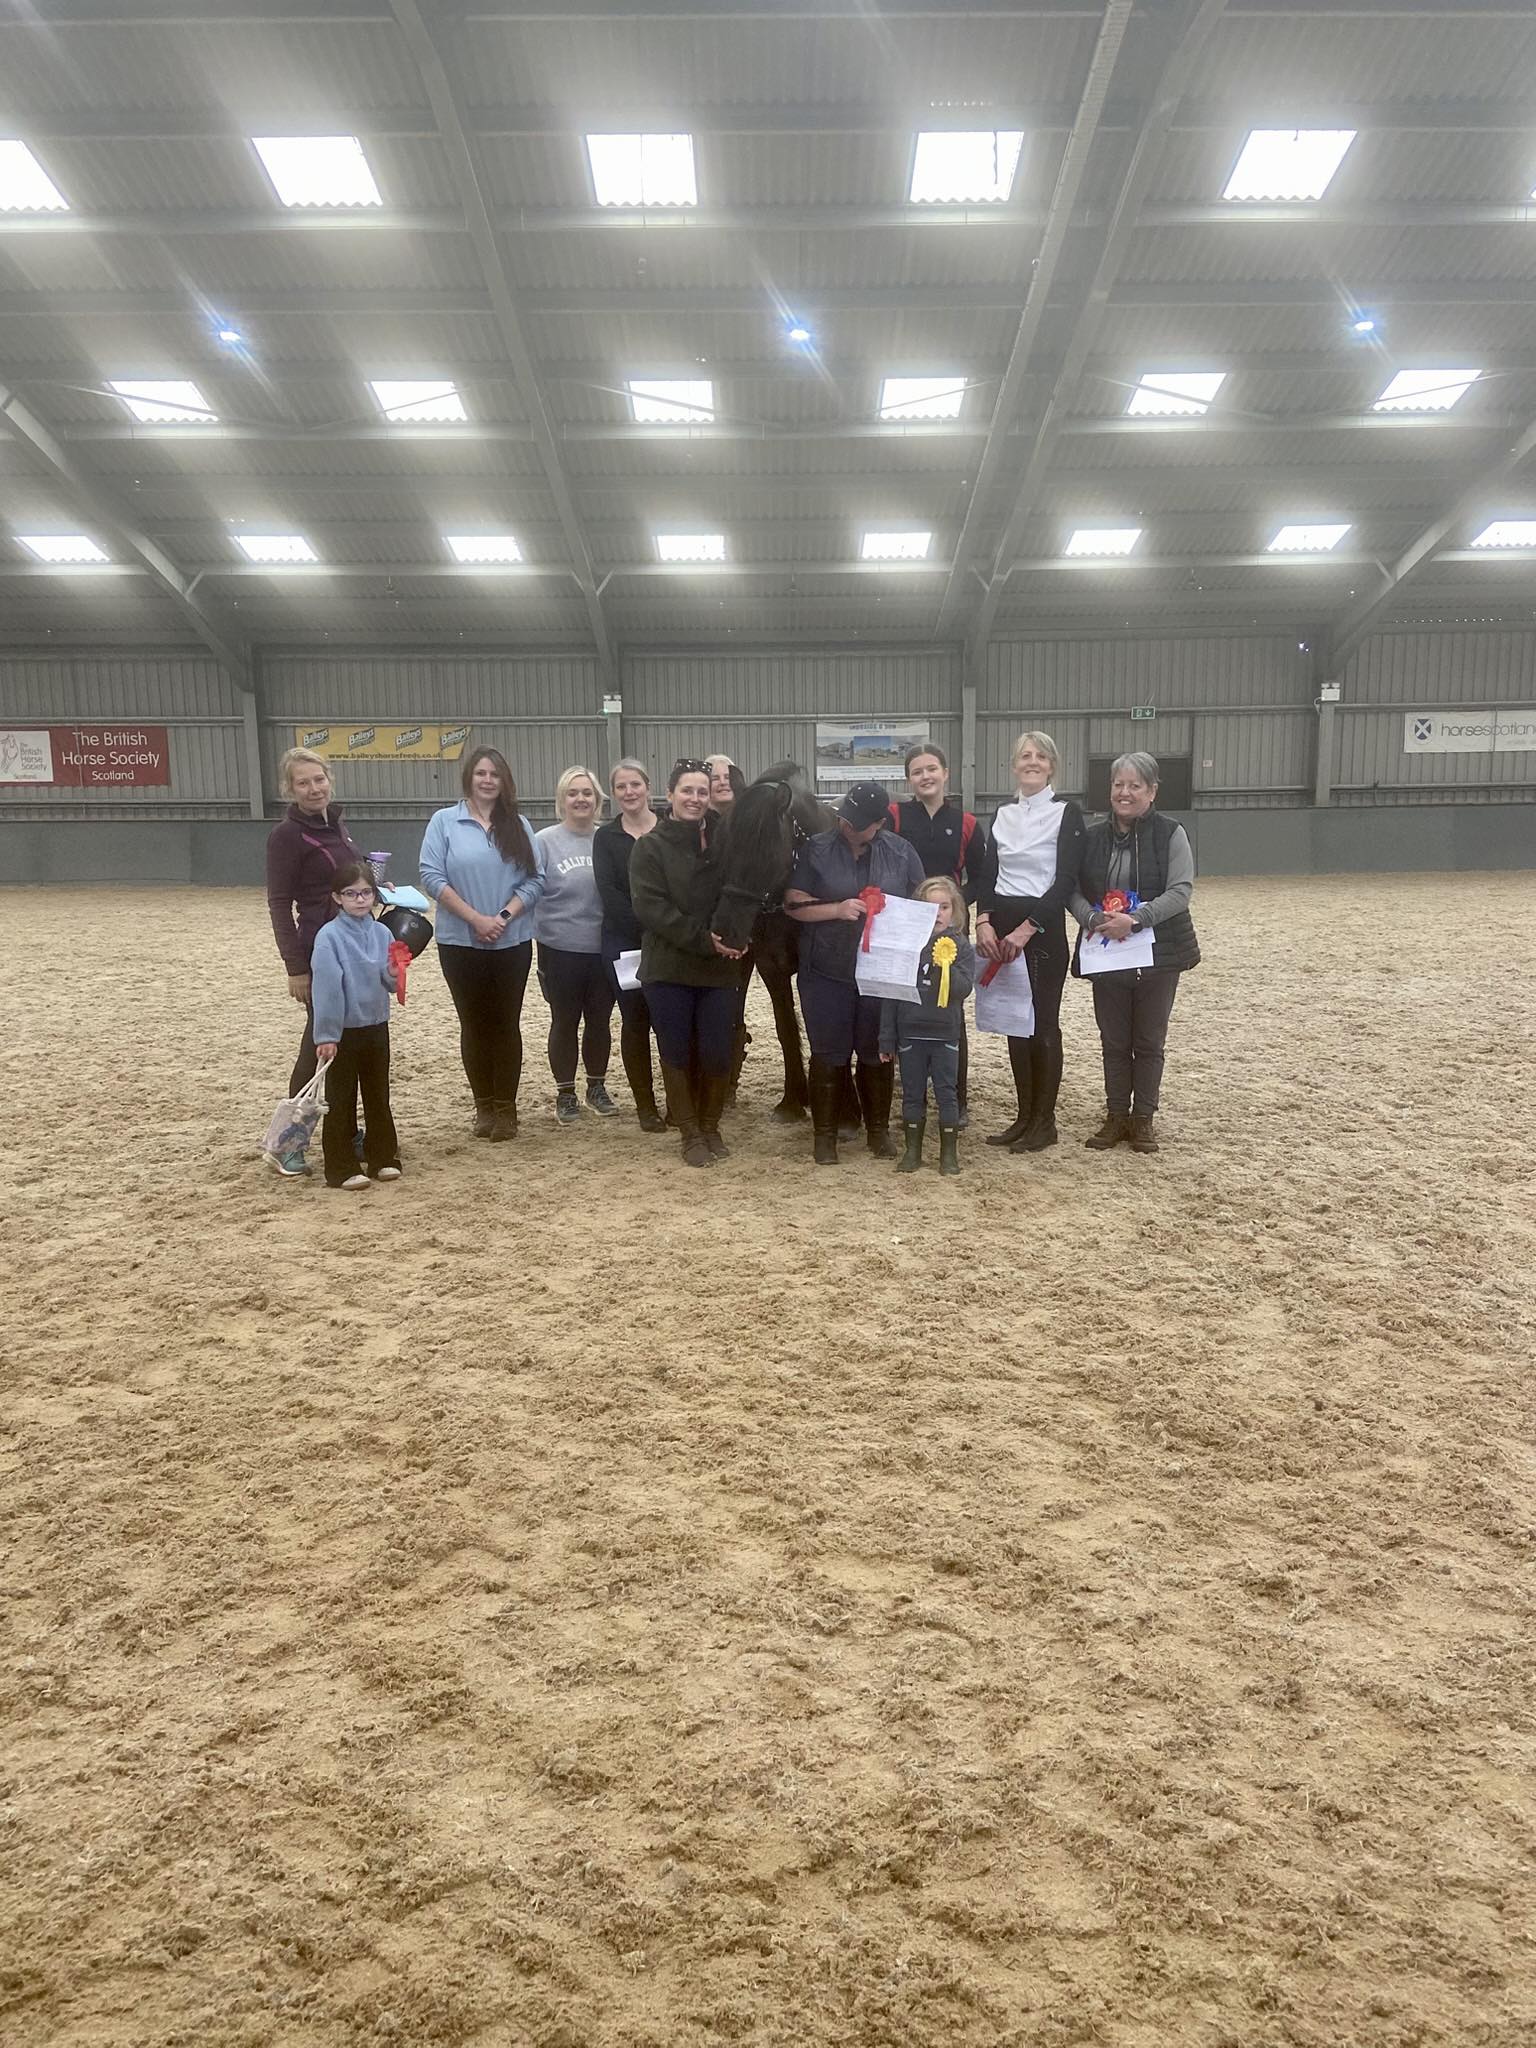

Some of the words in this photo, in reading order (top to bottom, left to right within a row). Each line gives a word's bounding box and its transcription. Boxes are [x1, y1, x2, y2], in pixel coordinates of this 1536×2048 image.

[72, 731, 100, 746] The
[103, 731, 148, 746] British
[303, 728, 329, 746] Baileys
[348, 728, 374, 745] Baileys
[396, 729, 421, 746] Baileys
[441, 728, 466, 745] Baileys
[62, 751, 106, 765] Horse
[109, 751, 160, 768] Society
[91, 770, 135, 781] Scotland
